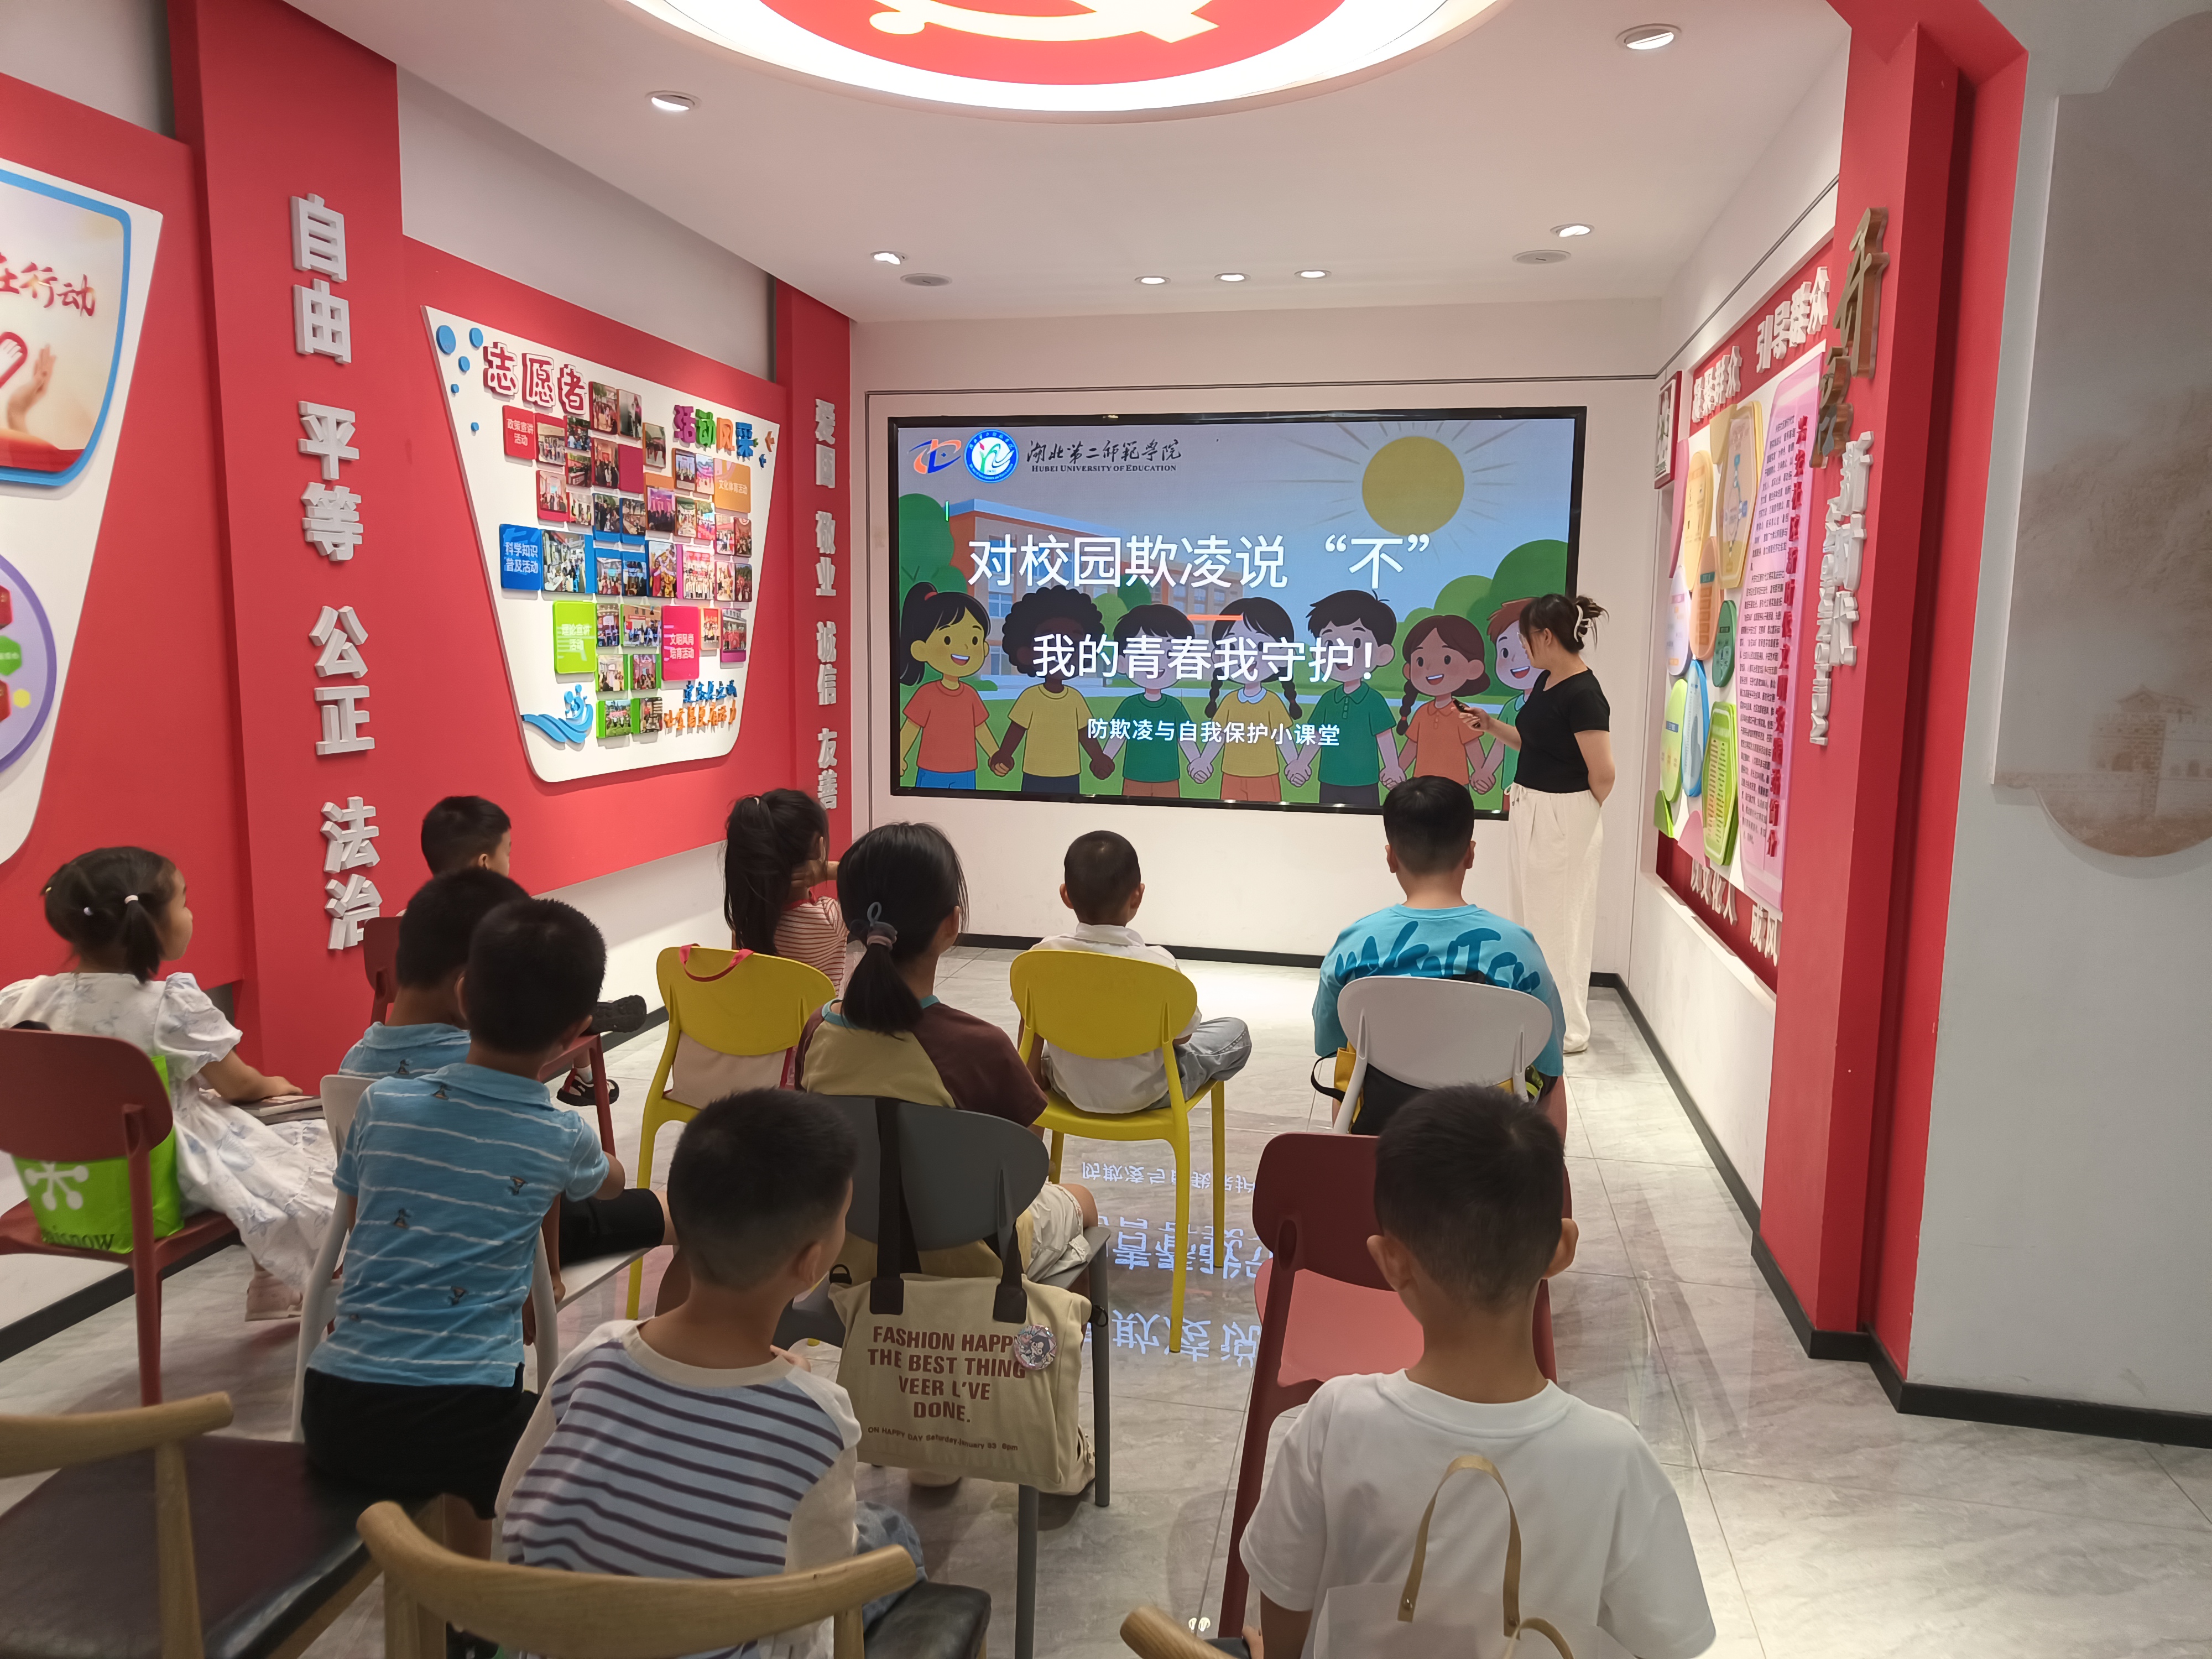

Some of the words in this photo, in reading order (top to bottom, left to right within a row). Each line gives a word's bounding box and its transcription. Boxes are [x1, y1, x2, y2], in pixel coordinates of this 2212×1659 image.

[290, 193, 352, 364] 自由
[483, 341, 588, 415] 志愿者
[514, 433, 528, 446] 活动
[673, 405, 754, 457] 活动风采
[298, 401, 363, 562] 平等
[504, 541, 538, 559] 科学知识
[505, 559, 539, 575] 普及活动
[309, 606, 375, 755] 公正
[816, 620, 837, 705] 诚信
[1087, 717, 1340, 747] 防欺凌与自我保护小课堂
[817, 728, 838, 810] 友善
[320, 796, 383, 950] 法治
[1690, 858, 1738, 926] 以文化人
[873, 1326, 955, 1351] FASHION
[961, 1334, 1017, 1353] HAPP
[867, 1349, 901, 1368] THE
[909, 1354, 957, 1374] BEST
[964, 1357, 1026, 1379] THING
[899, 1375, 945, 1396] VEER
[881, 1427, 905, 1438] HAPPY
[914, 1401, 971, 1423] DONE.
